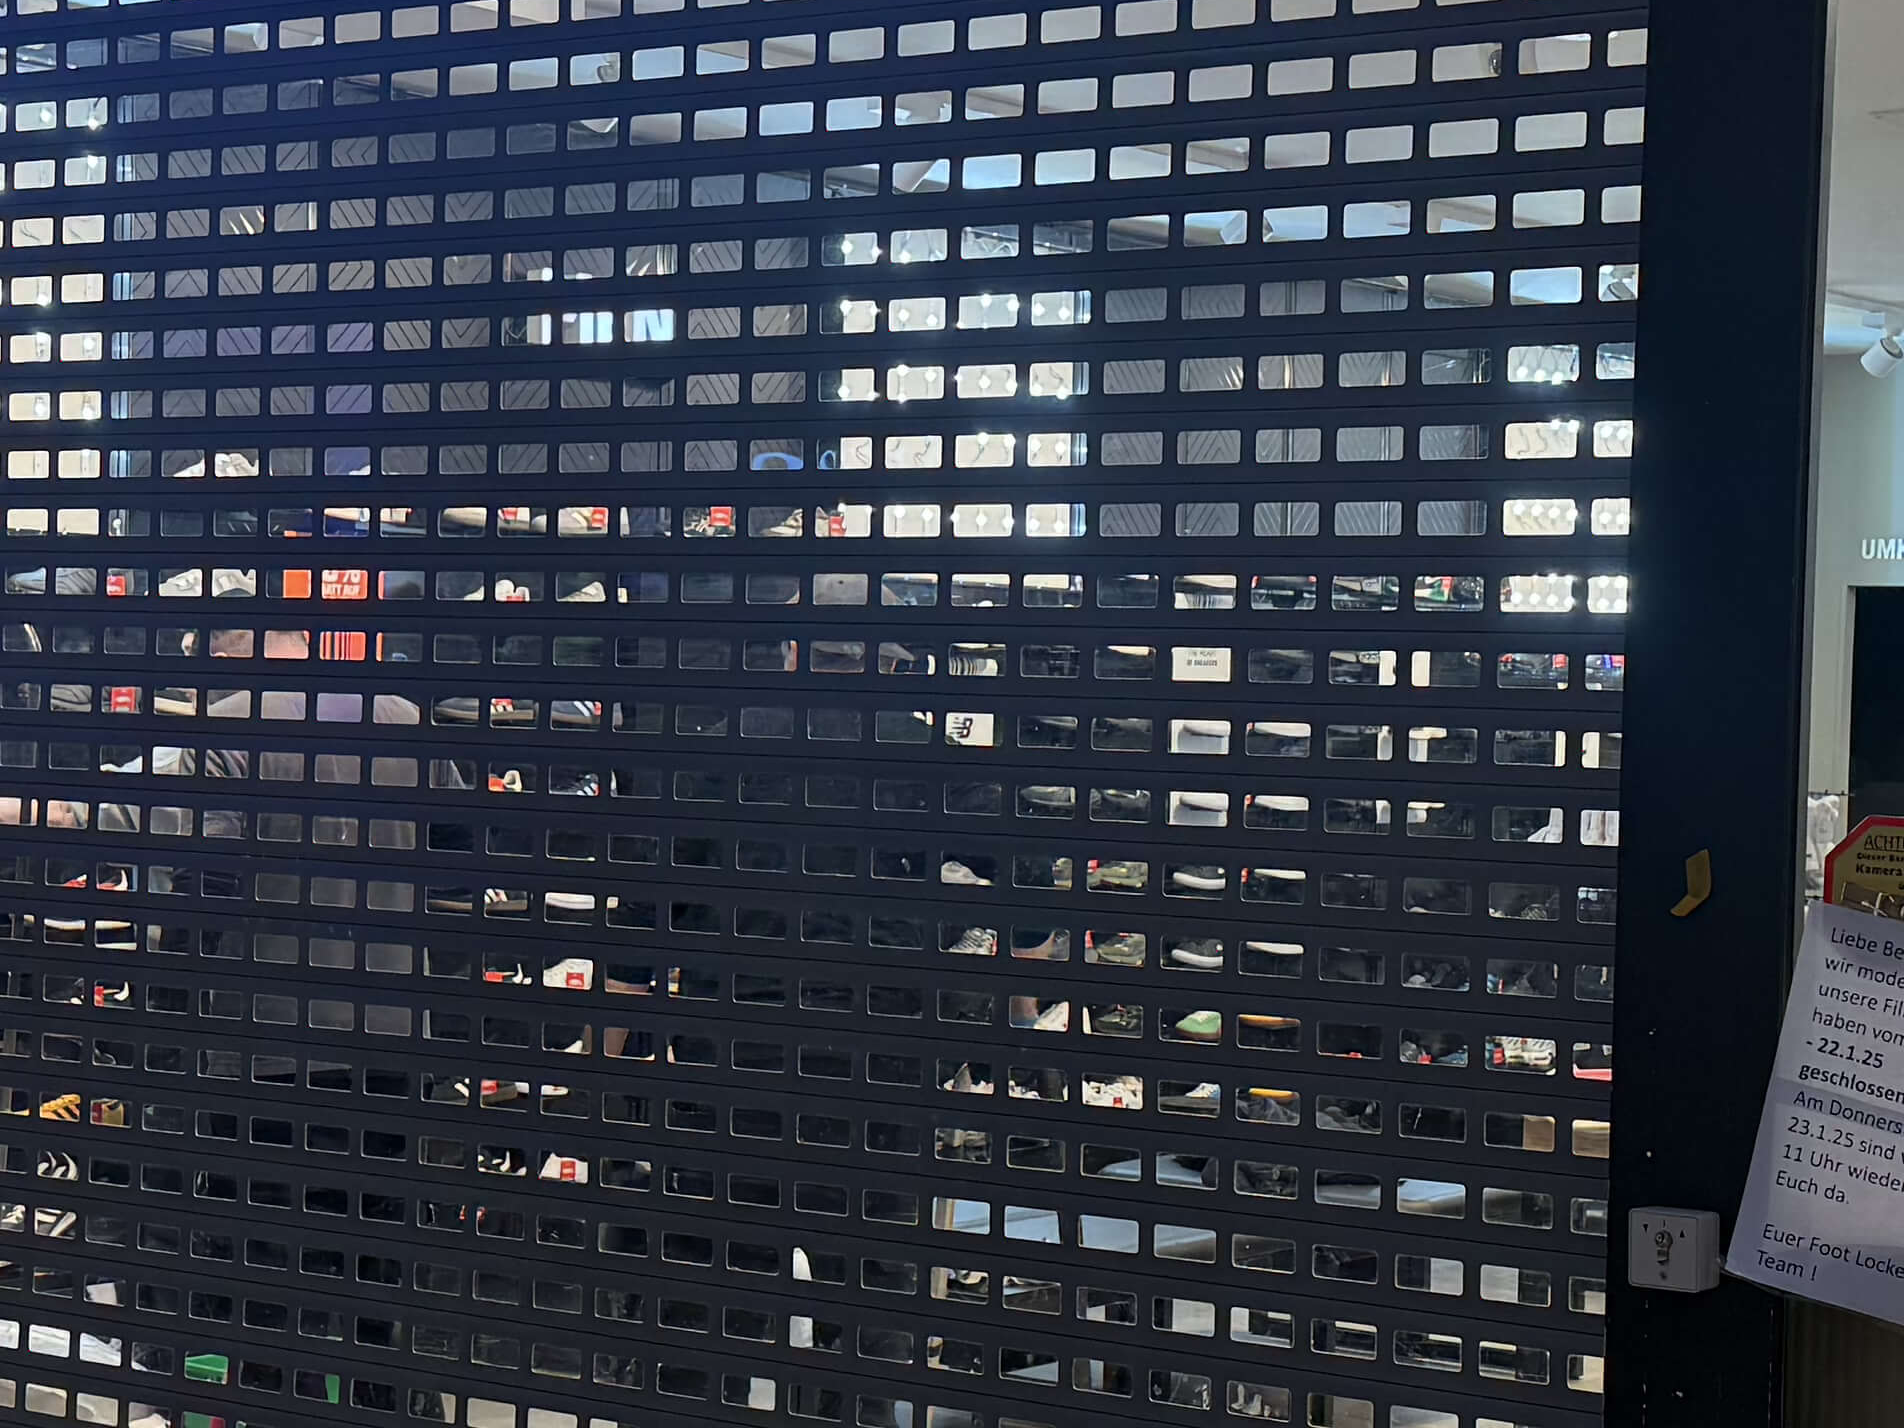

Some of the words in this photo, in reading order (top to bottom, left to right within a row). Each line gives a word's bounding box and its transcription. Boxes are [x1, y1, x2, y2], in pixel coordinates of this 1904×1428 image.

[1856, 864, 1903, 877] Kamera
[1831, 927, 1878, 953] Liebe
[1825, 957, 1854, 973] wir
[1818, 984, 1878, 1011] unsere
[1812, 1006, 1867, 1036] haben
[1817, 1037, 1885, 1069] 22.1.25
[1793, 1091, 1824, 1113] Am
[1788, 1116, 1855, 1148] 23.1.25
[1858, 1139, 1896, 1161] sind
[1783, 1144, 1803, 1163] 11
[1810, 1151, 1844, 1173] Uhr
[1776, 1169, 1818, 1195] Euch
[1824, 1183, 1849, 1204] da.
[1763, 1223, 1805, 1249] Euer
[1809, 1236, 1851, 1262] Foot
[1756, 1249, 1804, 1278] Team
